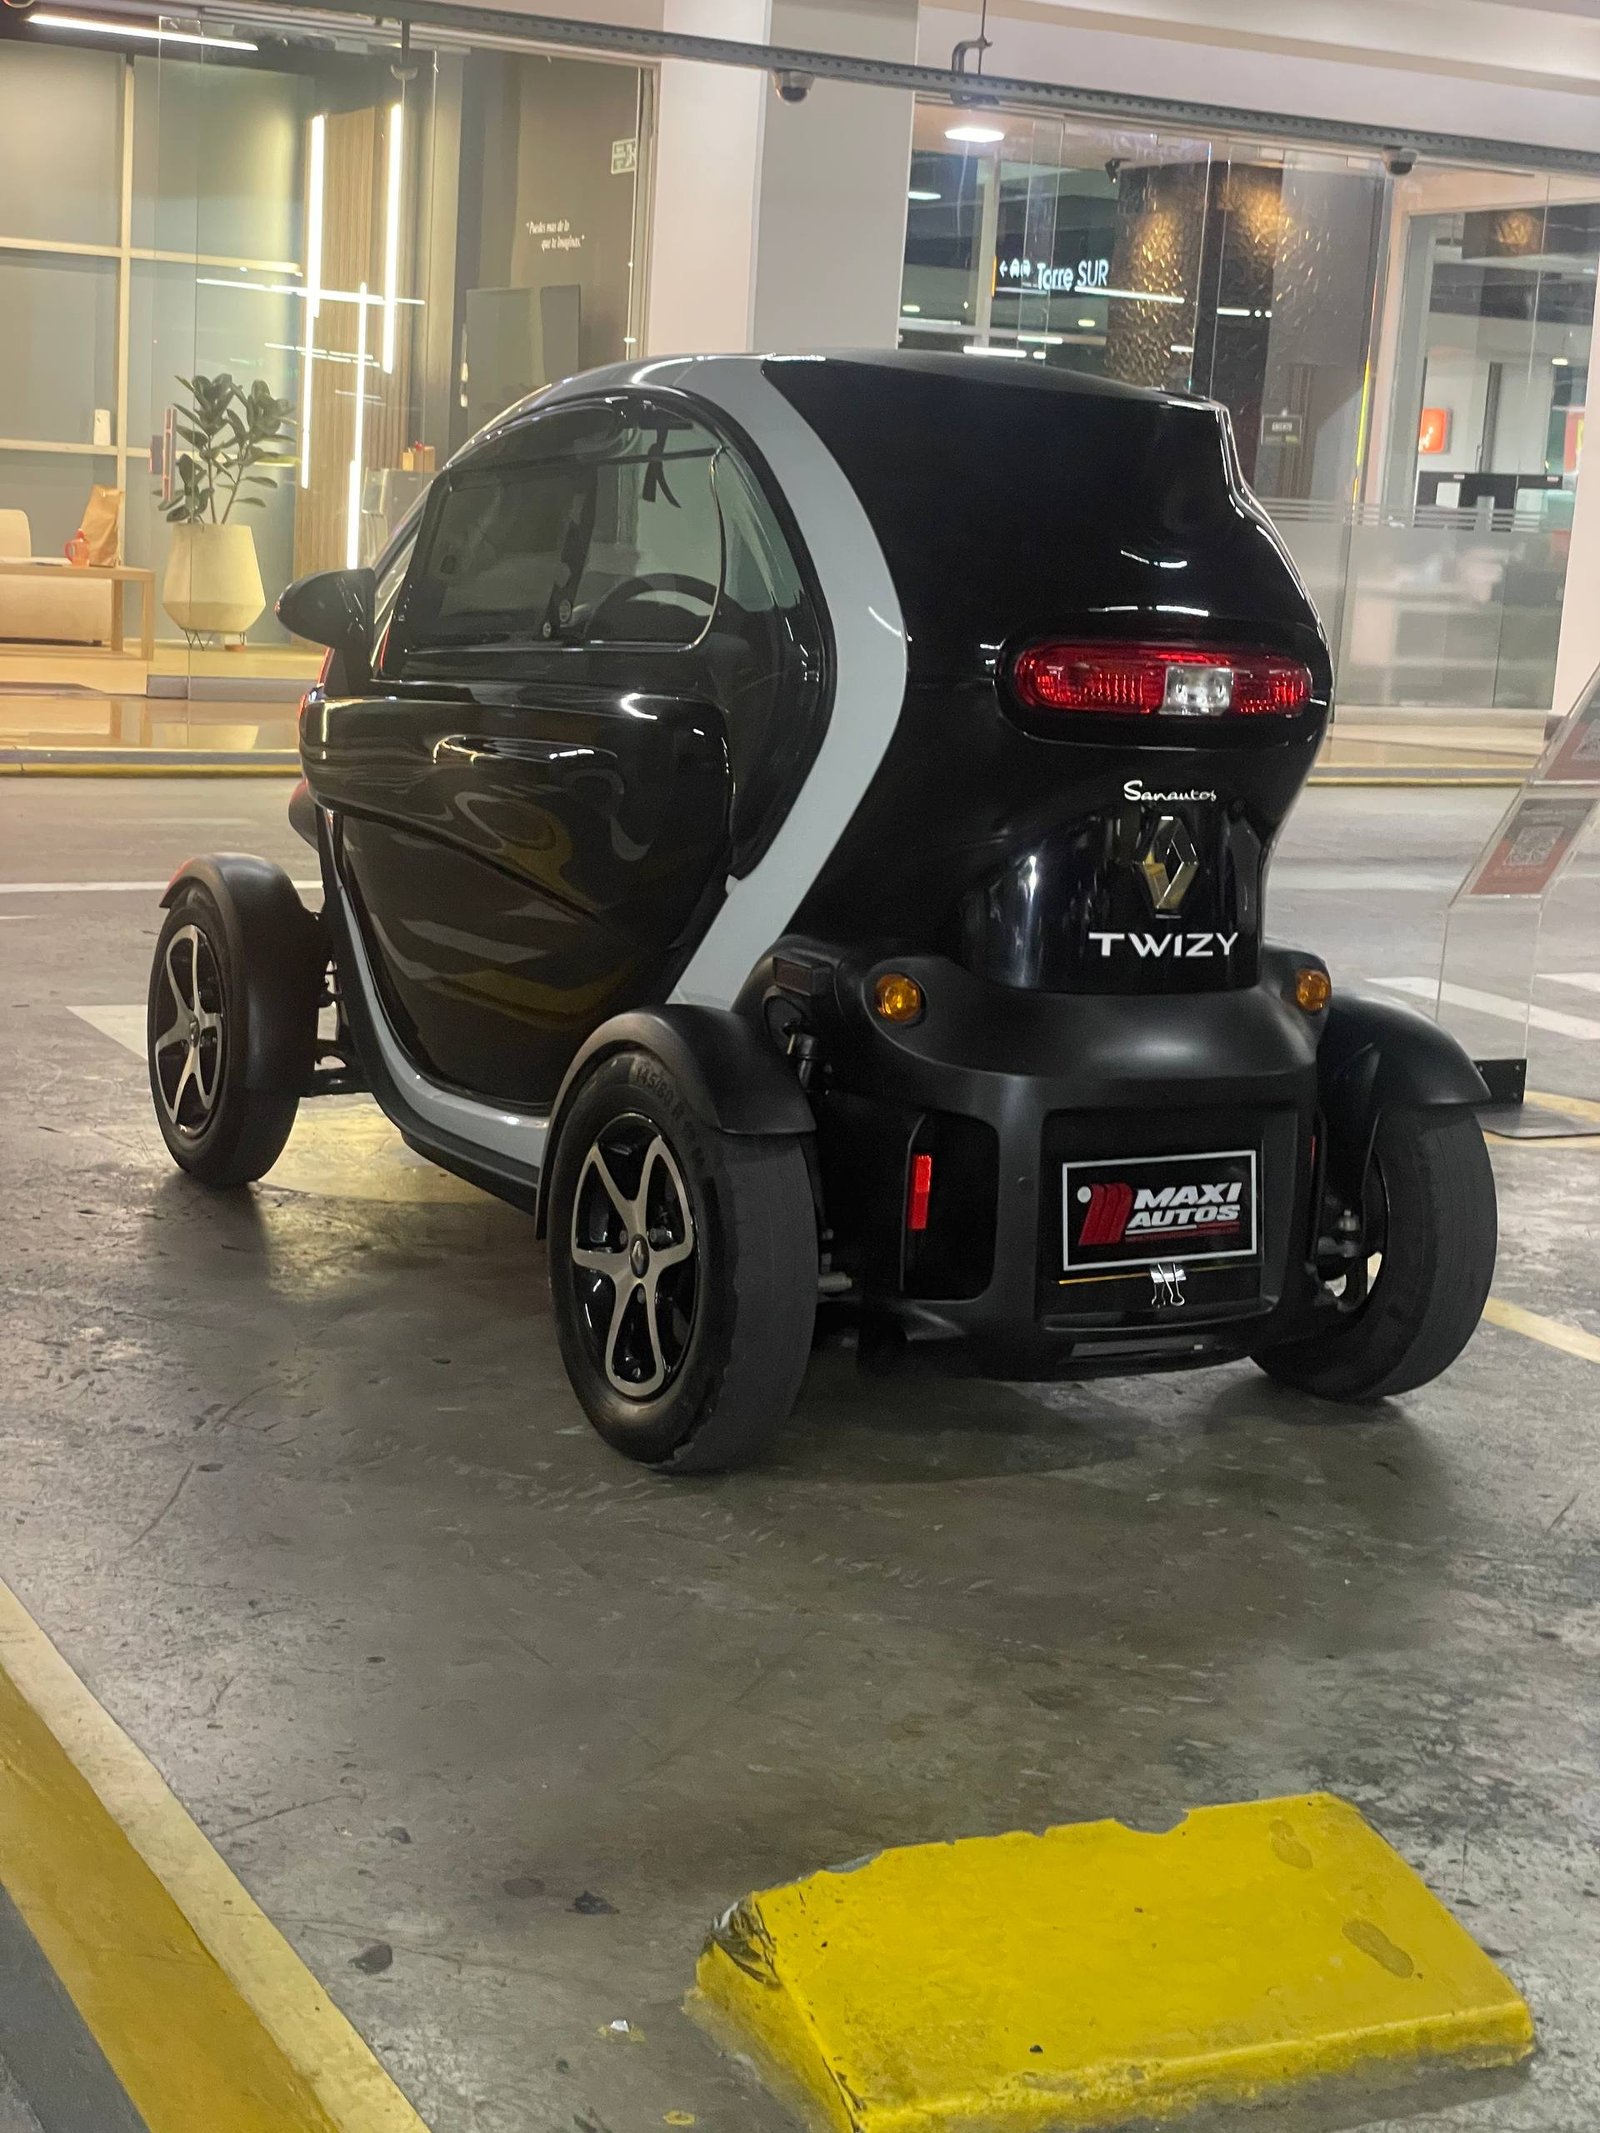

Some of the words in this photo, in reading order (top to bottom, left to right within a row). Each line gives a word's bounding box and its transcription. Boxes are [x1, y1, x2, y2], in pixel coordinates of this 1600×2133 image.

[1037, 262, 1074, 290] Torre
[1077, 258, 1109, 287] SUR
[1123, 779, 1217, 801] Sanautos
[1088, 931, 1239, 957] TWIZY
[1133, 1181, 1243, 1210] MAXI
[1126, 1204, 1241, 1229] AUTOS
